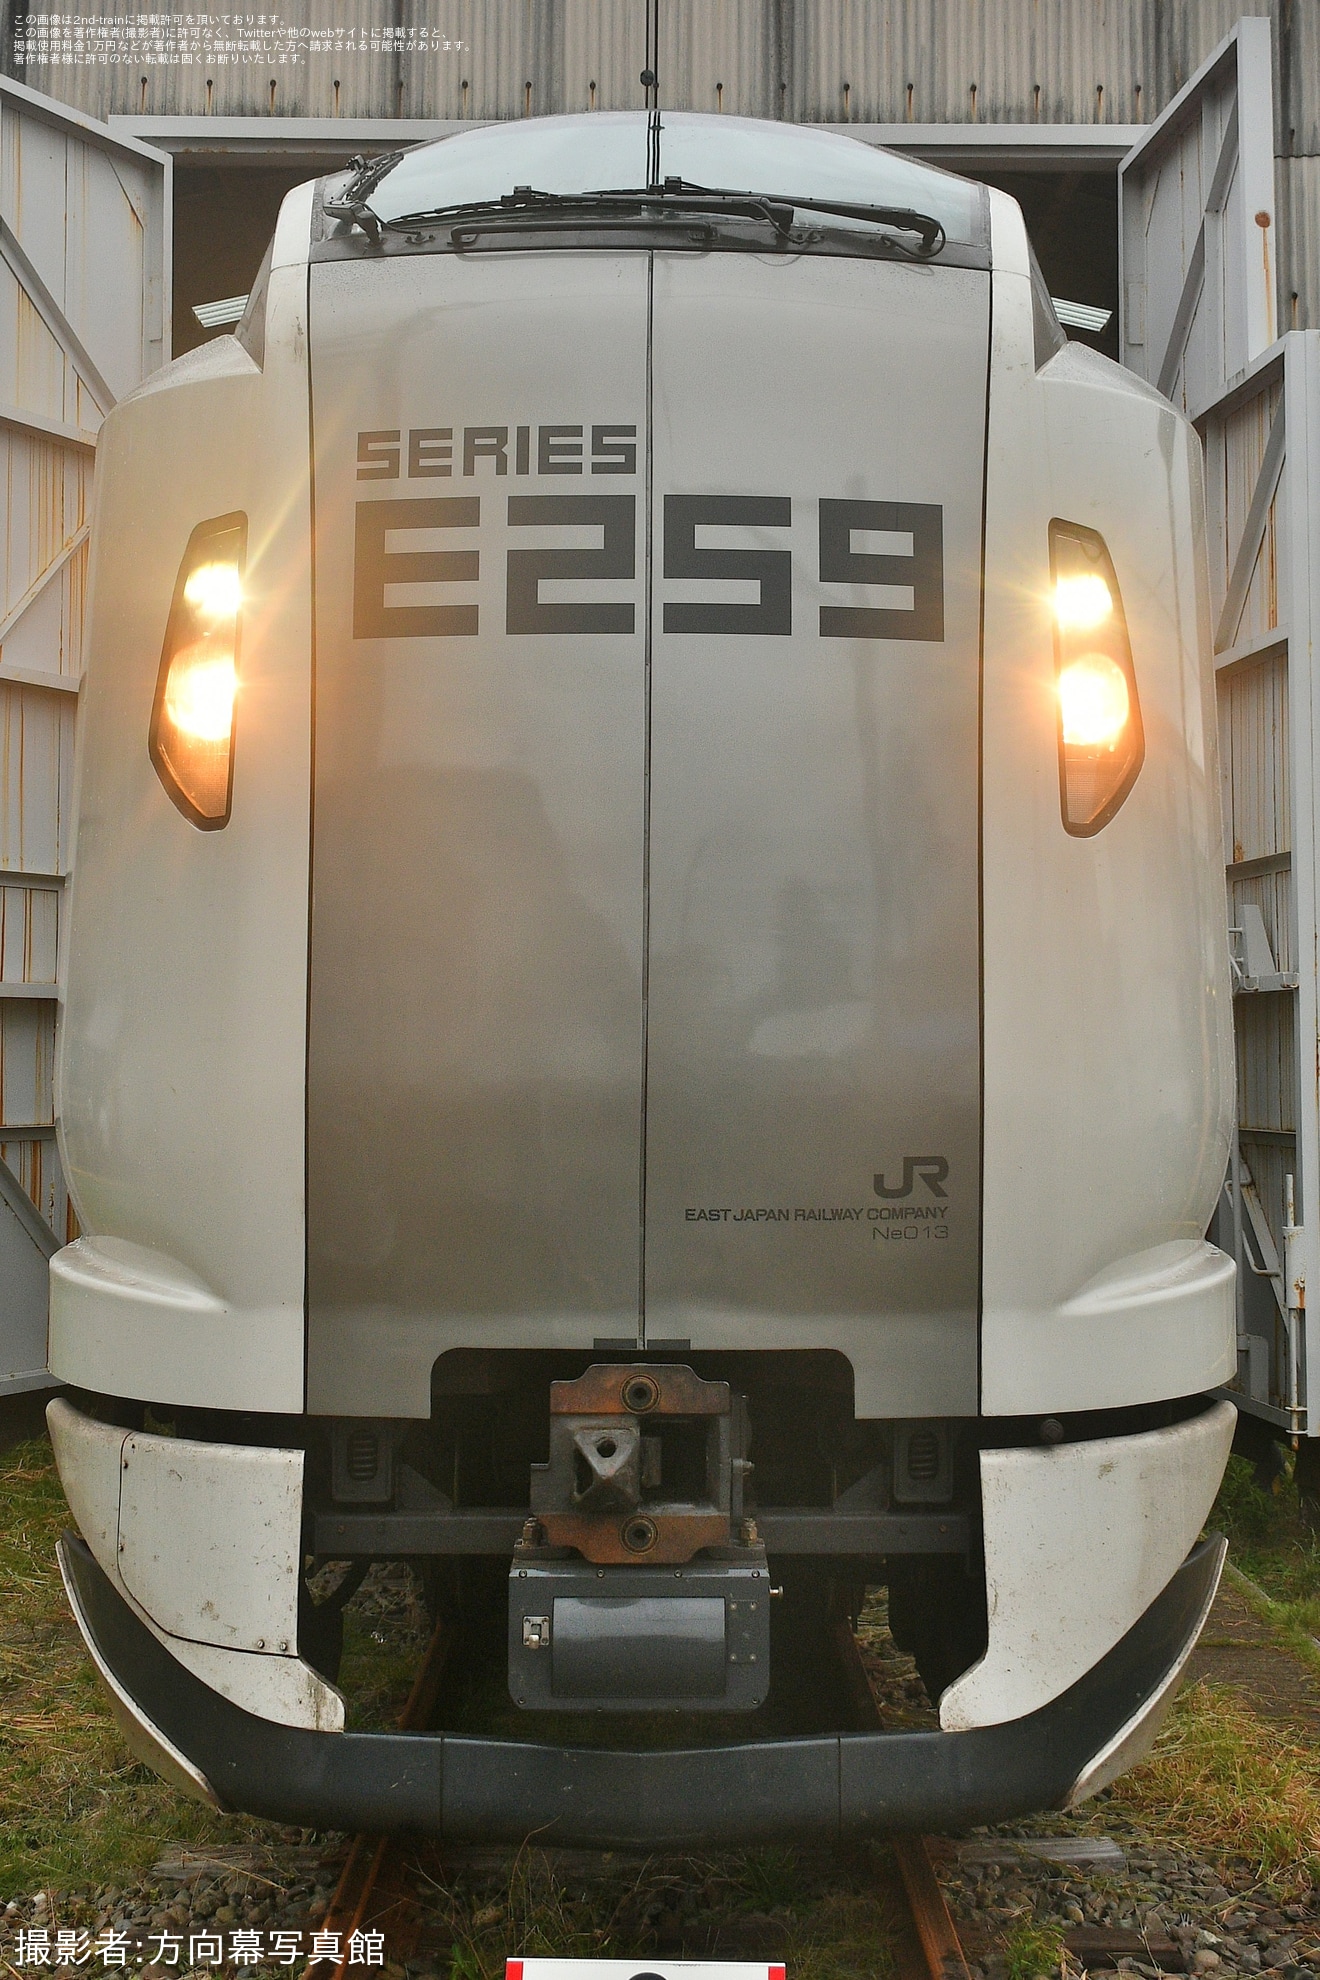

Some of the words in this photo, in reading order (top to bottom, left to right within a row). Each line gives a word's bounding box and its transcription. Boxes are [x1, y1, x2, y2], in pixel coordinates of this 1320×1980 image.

[356, 425, 637, 481] SERIES
[353, 494, 945, 642] E259
[873, 1156, 950, 1199] JR
[685, 1208, 732, 1222] EAST
[733, 1208, 790, 1222] JAPAN
[794, 1207, 864, 1222] RAILWAY
[867, 1206, 949, 1221] COMPANY
[872, 1225, 949, 1240] Ne013
